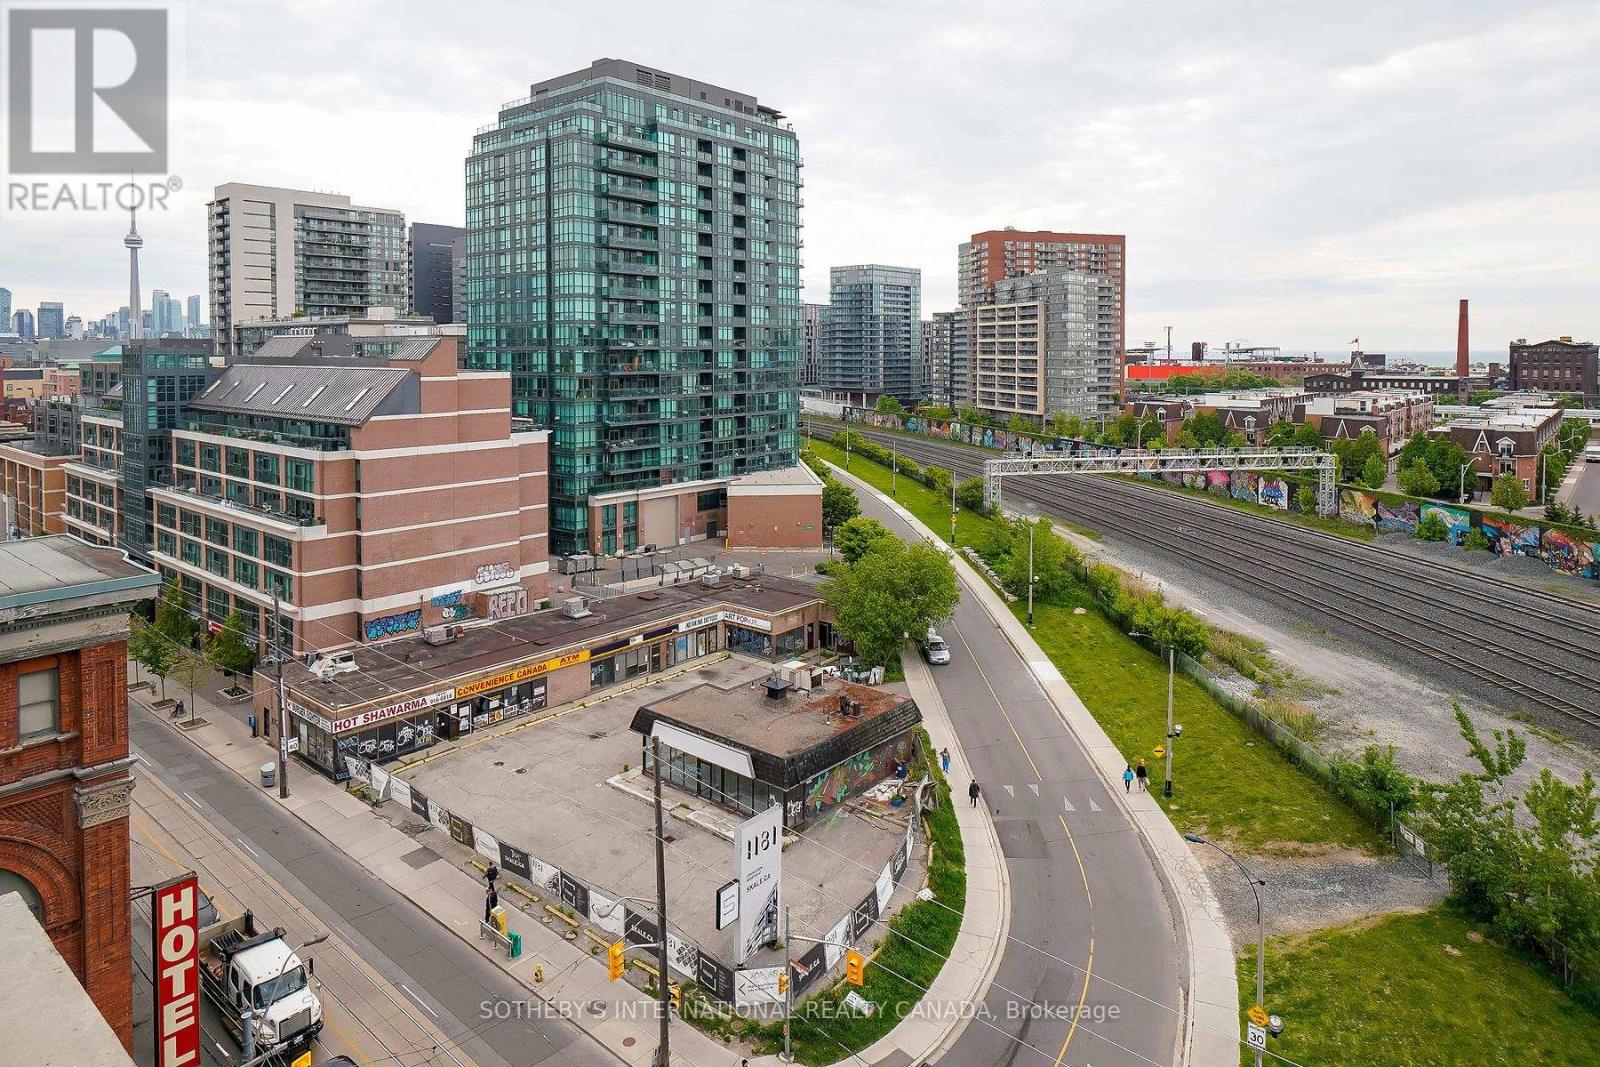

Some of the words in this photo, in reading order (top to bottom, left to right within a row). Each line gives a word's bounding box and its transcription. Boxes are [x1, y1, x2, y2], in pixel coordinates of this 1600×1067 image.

[724, 612, 736, 620] ART
[559, 653, 580, 664] ATM
[457, 673, 515, 696] CONVENIENCE
[516, 663, 548, 679] CANADA
[334, 716, 359, 732] HOT
[363, 697, 428, 723] SHAWARMA
[288, 741, 298, 750] 40
[417, 735, 432, 745] ATM
[161, 886, 197, 1067] HOTEL
[1249, 1031, 1264, 1045] 30
